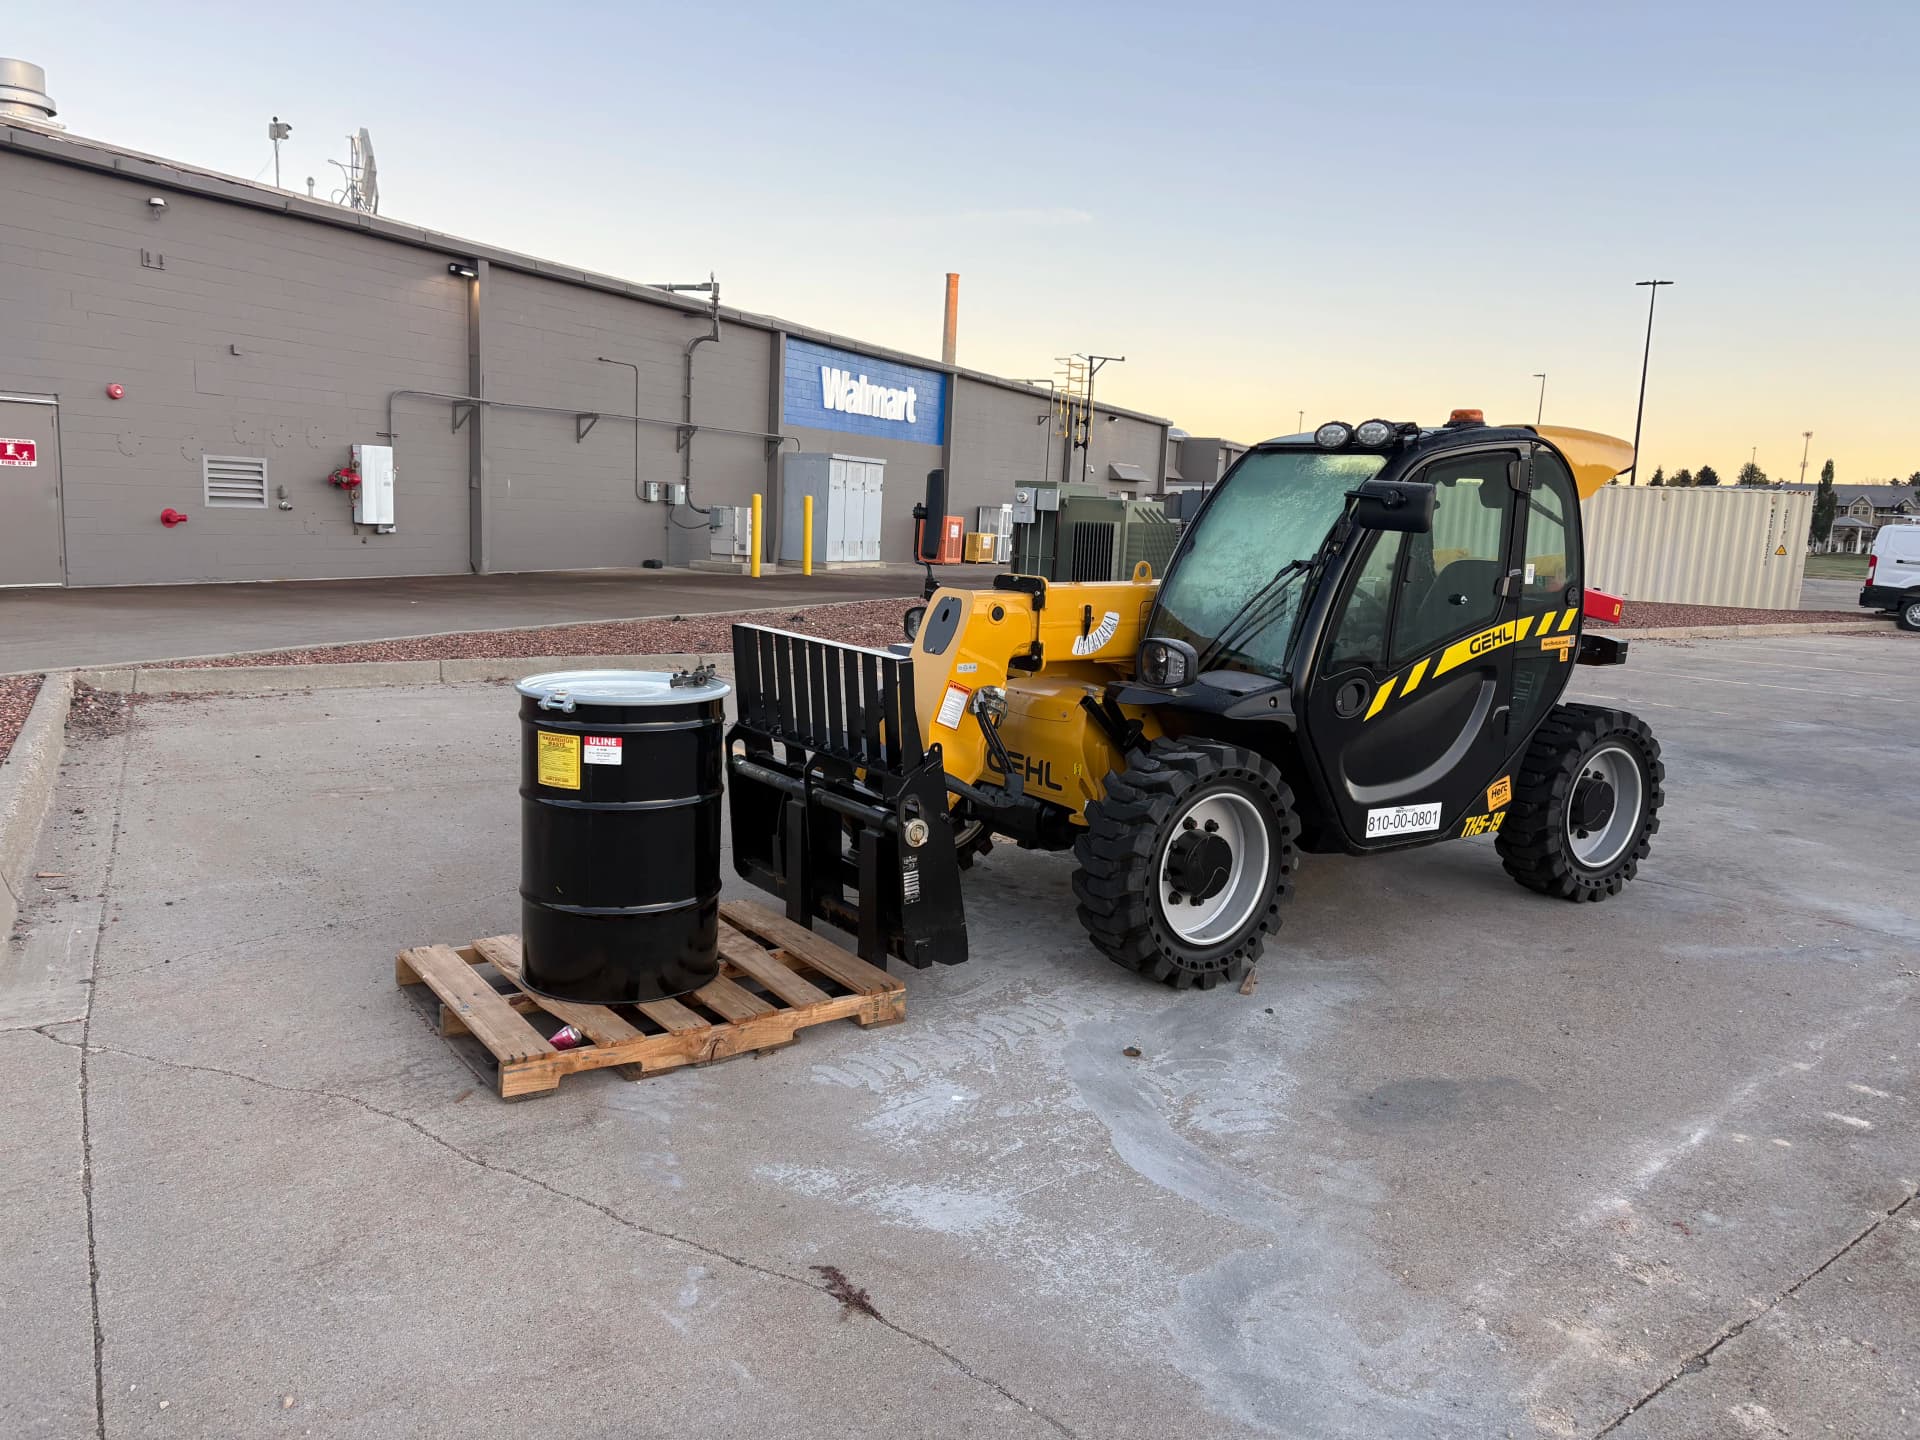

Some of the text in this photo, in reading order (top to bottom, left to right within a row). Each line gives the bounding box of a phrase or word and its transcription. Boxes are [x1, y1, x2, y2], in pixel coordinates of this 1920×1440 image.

[821, 366, 917, 423] Walmart
[1469, 626, 1513, 655] GEHL
[590, 736, 616, 746] ULINE
[1491, 784, 1508, 799] Herc
[1367, 810, 1438, 832] 810-00-0801
[1461, 811, 1506, 838] TH5-19
